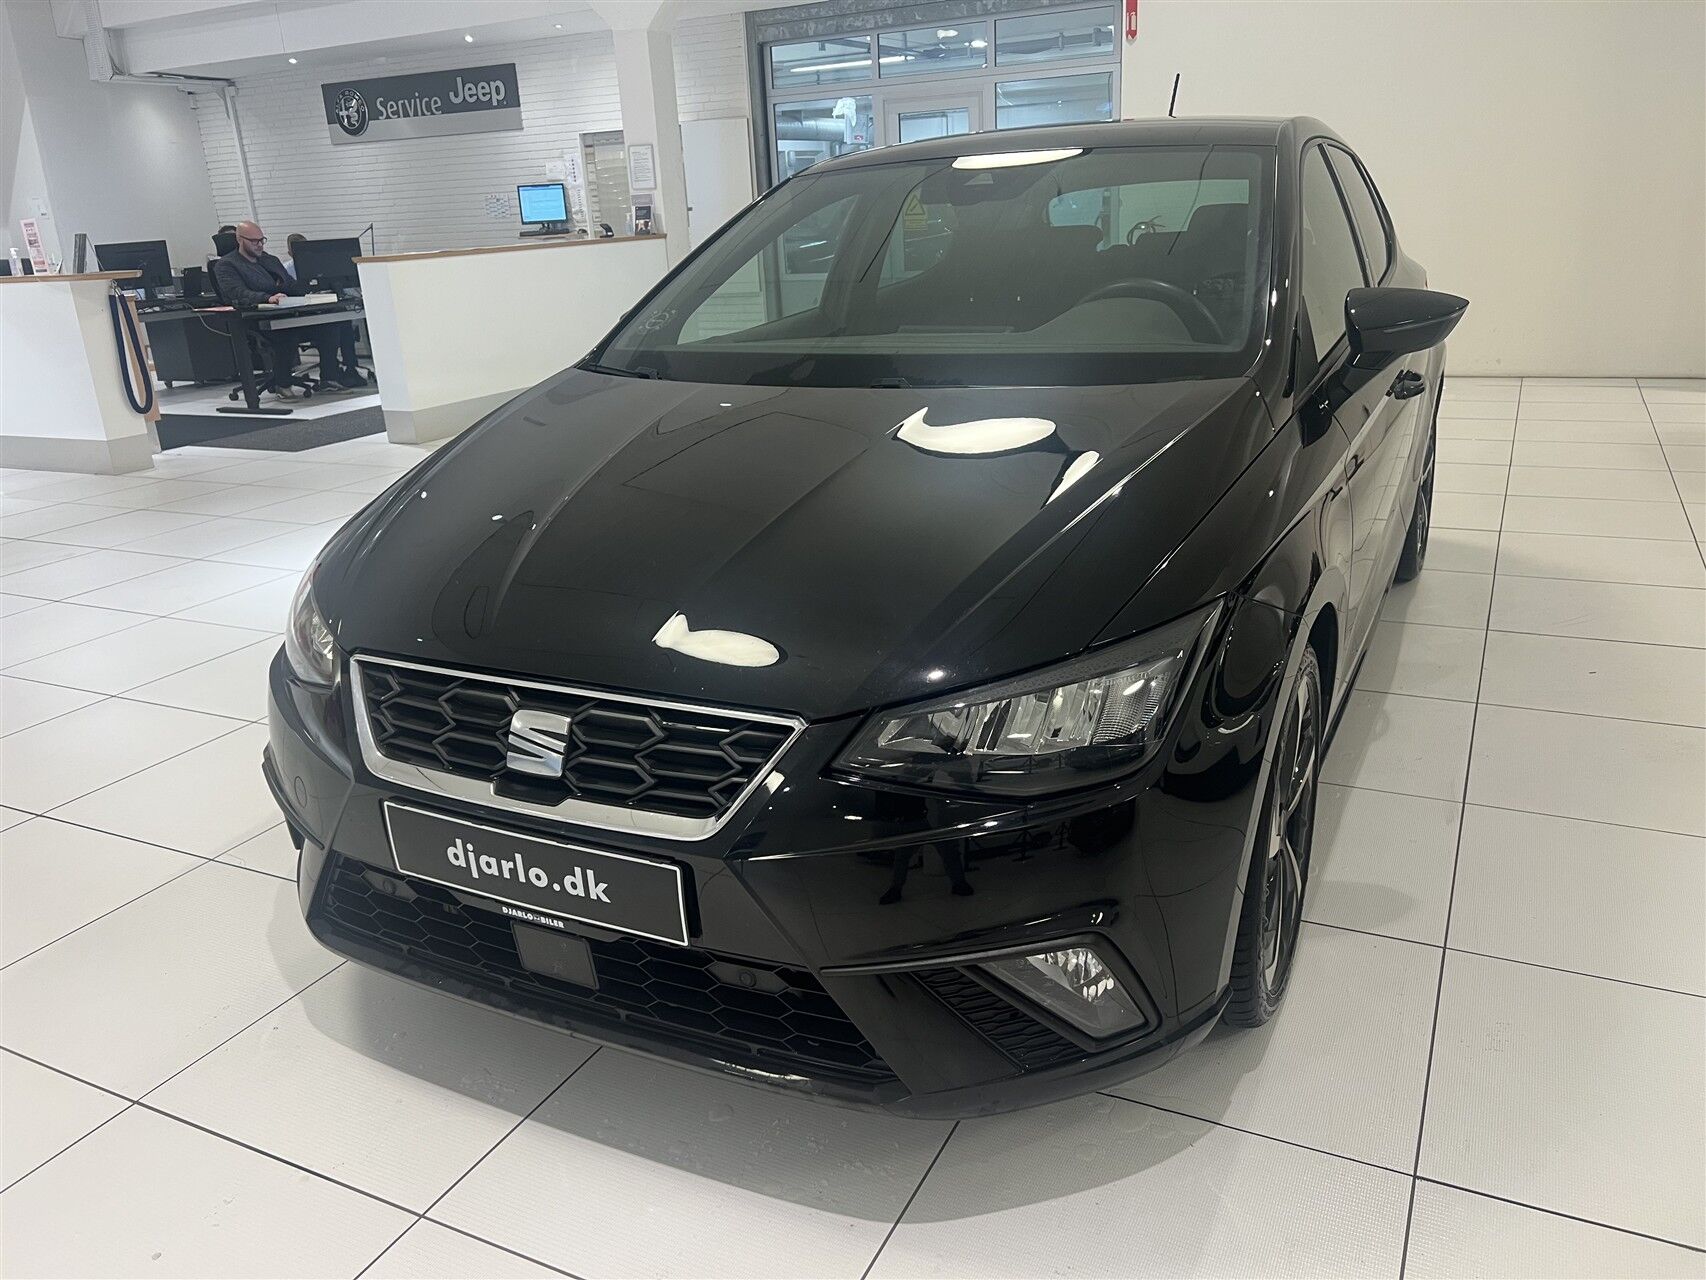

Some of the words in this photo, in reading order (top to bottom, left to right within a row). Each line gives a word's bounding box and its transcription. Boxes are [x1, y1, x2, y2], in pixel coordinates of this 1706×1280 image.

[377, 92, 442, 120] Service
[449, 76, 507, 105] Jeep
[446, 838, 611, 903] djarlo.dk
[502, 906, 534, 920] DJARLO
[540, 916, 565, 928] BILER
